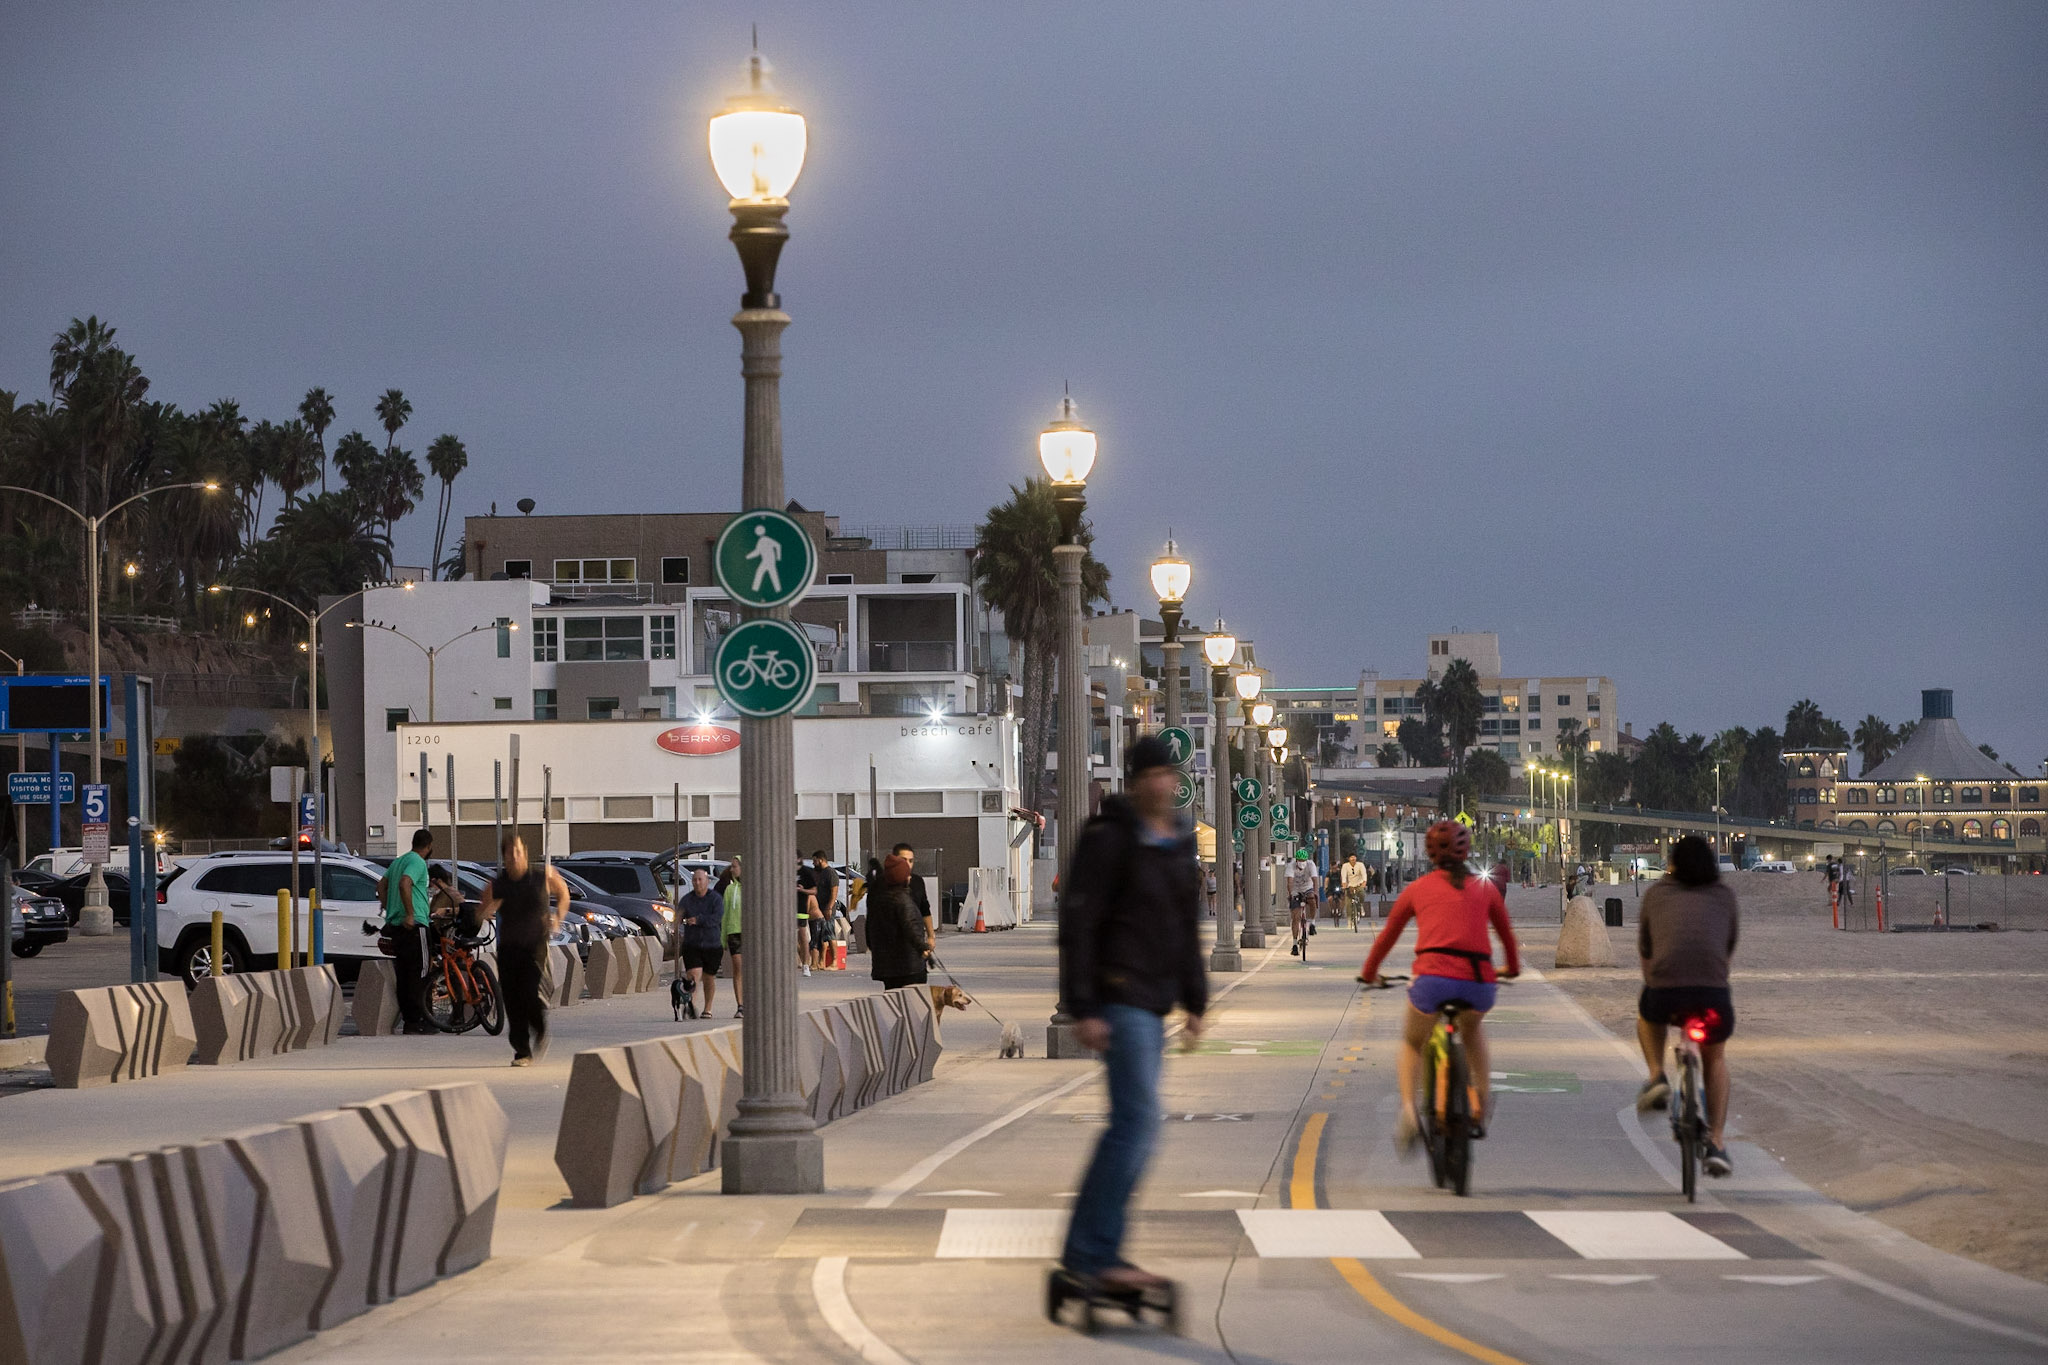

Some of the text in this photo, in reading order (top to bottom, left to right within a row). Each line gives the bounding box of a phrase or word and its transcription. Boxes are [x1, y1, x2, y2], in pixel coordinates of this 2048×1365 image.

[901, 726, 948, 737] beach
[408, 735, 440, 744] 1200
[670, 734, 731, 743] PERRY'S
[166, 743, 174, 752] IN
[86, 790, 104, 817] 5
